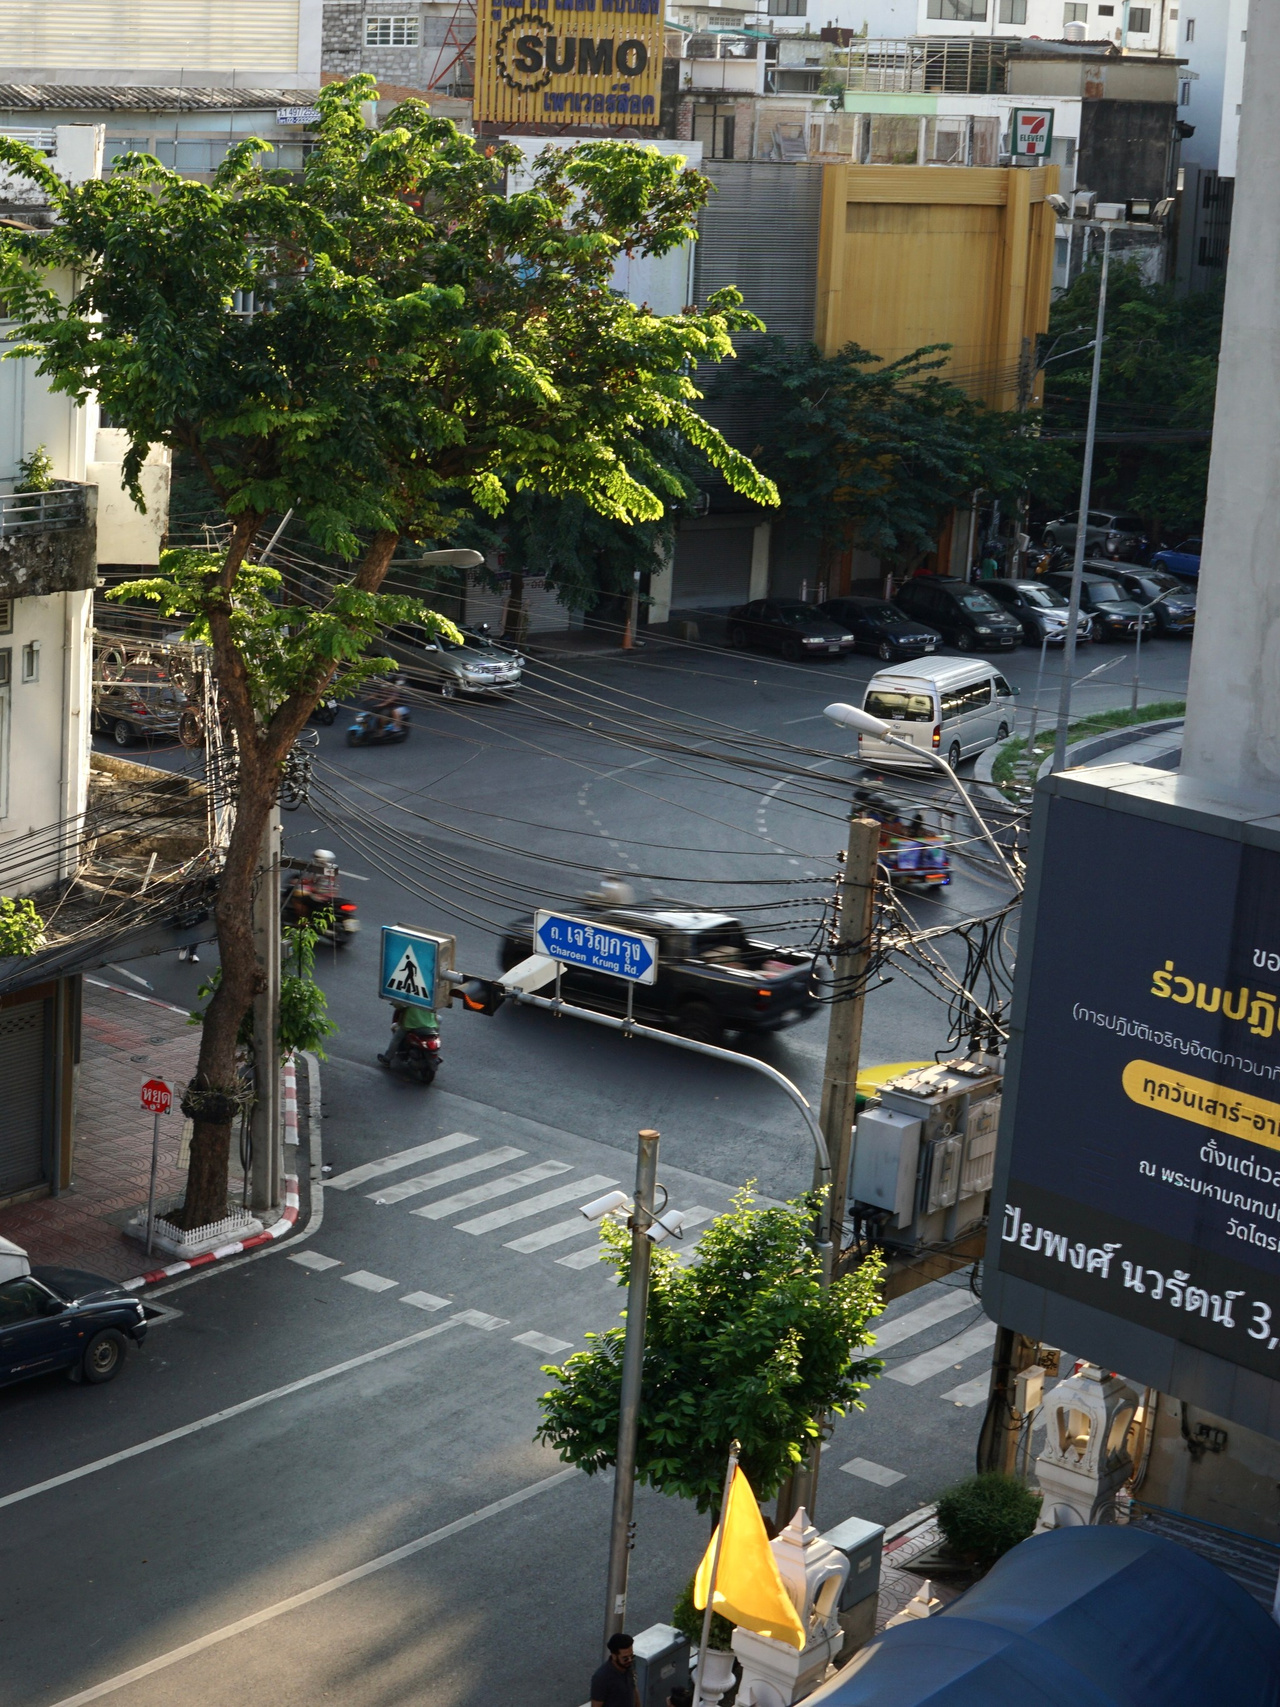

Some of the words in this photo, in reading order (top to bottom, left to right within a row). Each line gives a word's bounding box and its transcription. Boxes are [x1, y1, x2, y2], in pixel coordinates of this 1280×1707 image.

[513, 35, 648, 76] SUMO
[1021, 116, 1046, 153] 7
[550, 926, 562, 941] ถ.
[567, 926, 641, 964] เจริญกรุง
[550, 944, 587, 961] Charoen
[592, 955, 620, 972] Krung
[624, 964, 639, 976] Rd.
[1150, 960, 1280, 1038] ร่วมปฏิ
[143, 1087, 171, 1108] หยุด
[1143, 1078, 1280, 1138] ทุกวันเสาร์-อา
[1139, 1160, 1156, 1177] ณ
[1121, 1260, 1246, 1328] นวรัตน์
[1247, 1301, 1280, 1350] 3,
